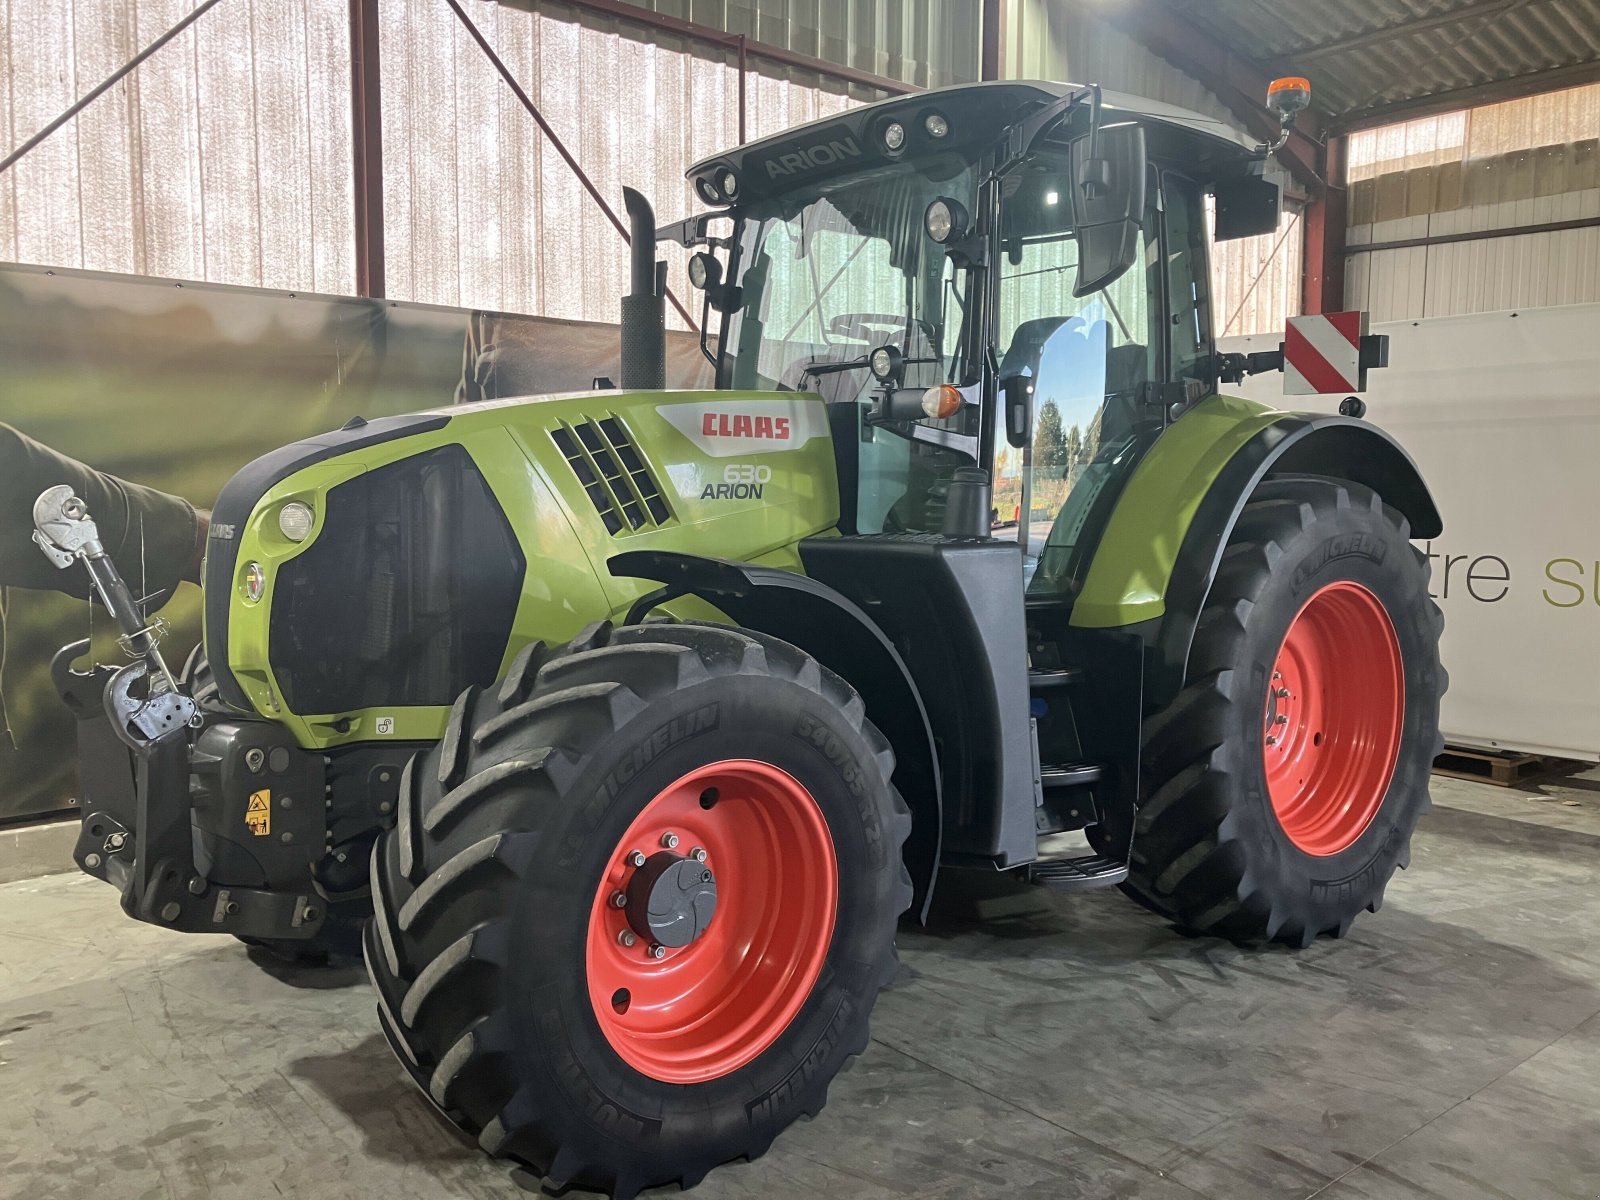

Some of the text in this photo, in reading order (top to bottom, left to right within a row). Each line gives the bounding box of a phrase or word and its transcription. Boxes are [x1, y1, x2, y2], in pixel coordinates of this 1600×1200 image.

[764, 137, 862, 179] ARION
[703, 413, 790, 439] CLAAS
[723, 464, 772, 484] 630
[700, 483, 763, 500] ARION
[1542, 558, 1600, 609] s
